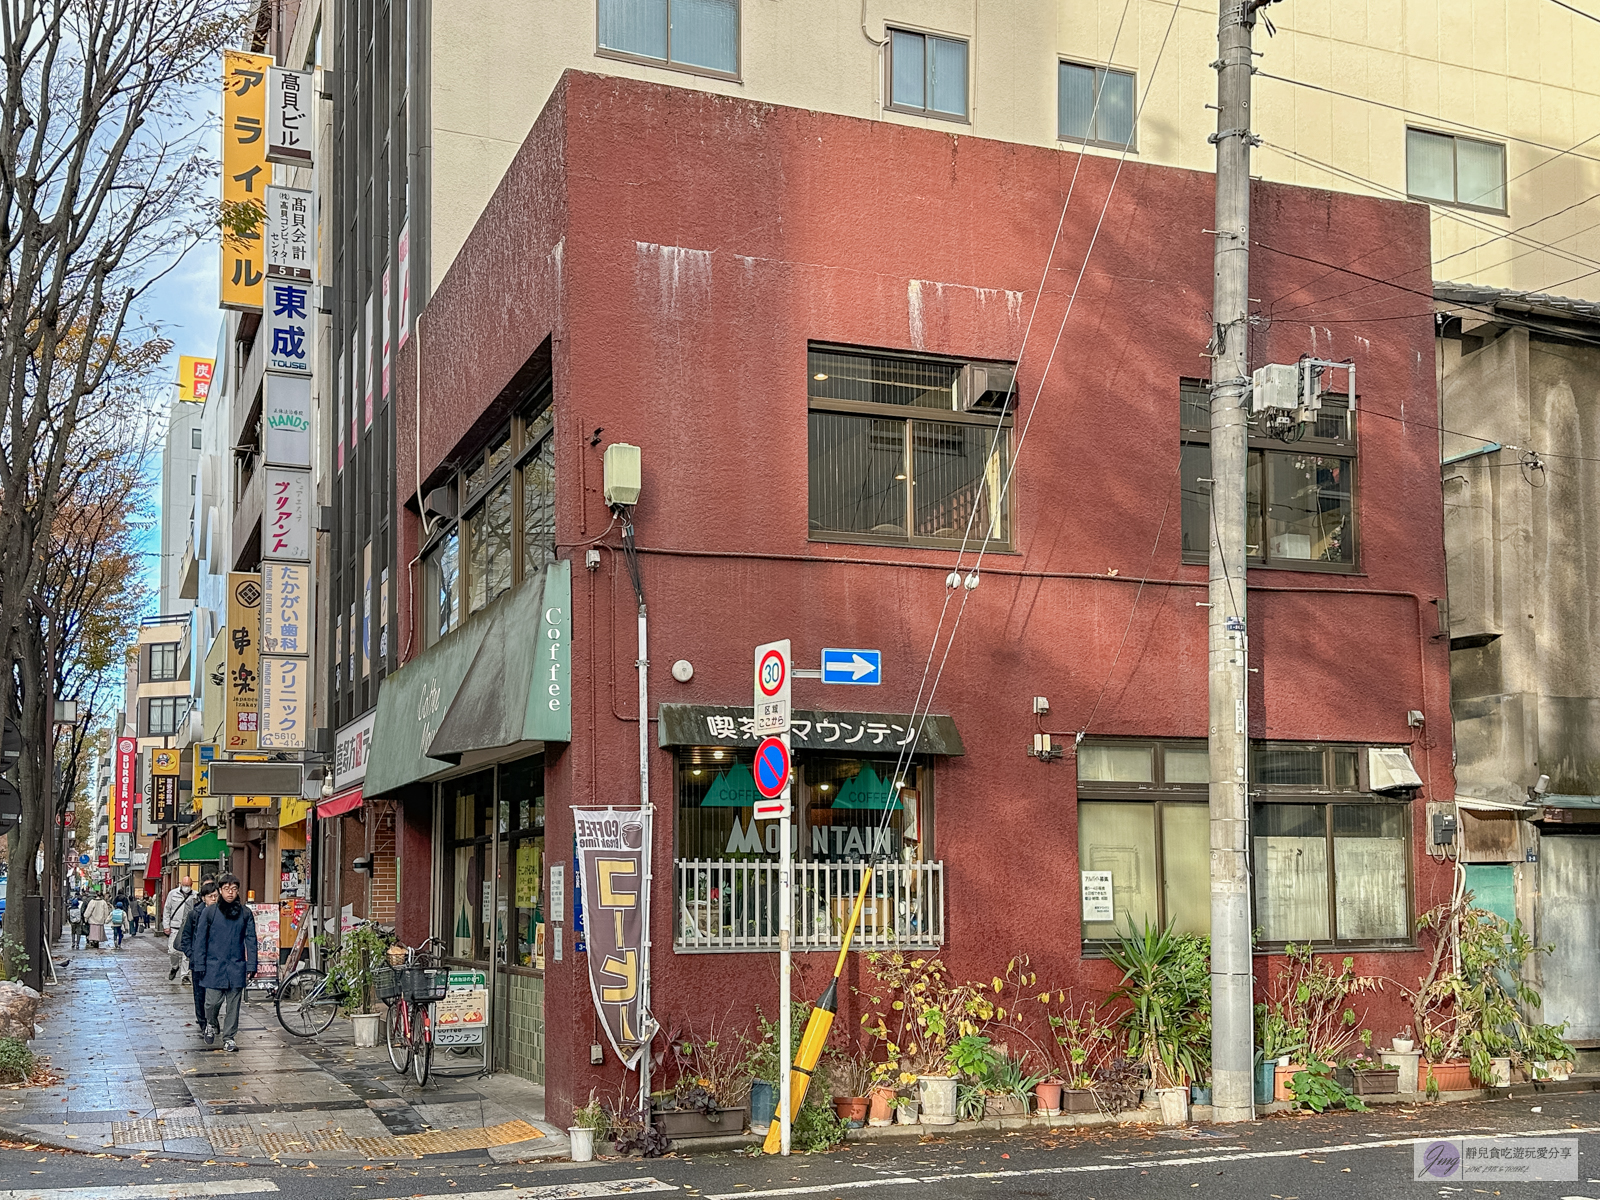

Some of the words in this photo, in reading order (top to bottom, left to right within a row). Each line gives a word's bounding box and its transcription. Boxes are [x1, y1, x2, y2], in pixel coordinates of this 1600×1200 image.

[271, 286, 307, 358] 東成
[271, 359, 307, 370] TOUSEI
[267, 415, 309, 431] HANDS
[280, 566, 300, 651] たかがい歯科
[545, 607, 562, 711] Coffee
[764, 662, 780, 684] 30
[263, 688, 271, 709] DENTAL
[279, 660, 297, 731] クリニック
[760, 716, 784, 727] ここから
[230, 736, 247, 746] 2F
[121, 754, 129, 799] BURGER
[719, 789, 767, 801] COFFE
[438, 1034, 480, 1043] マウンテン
